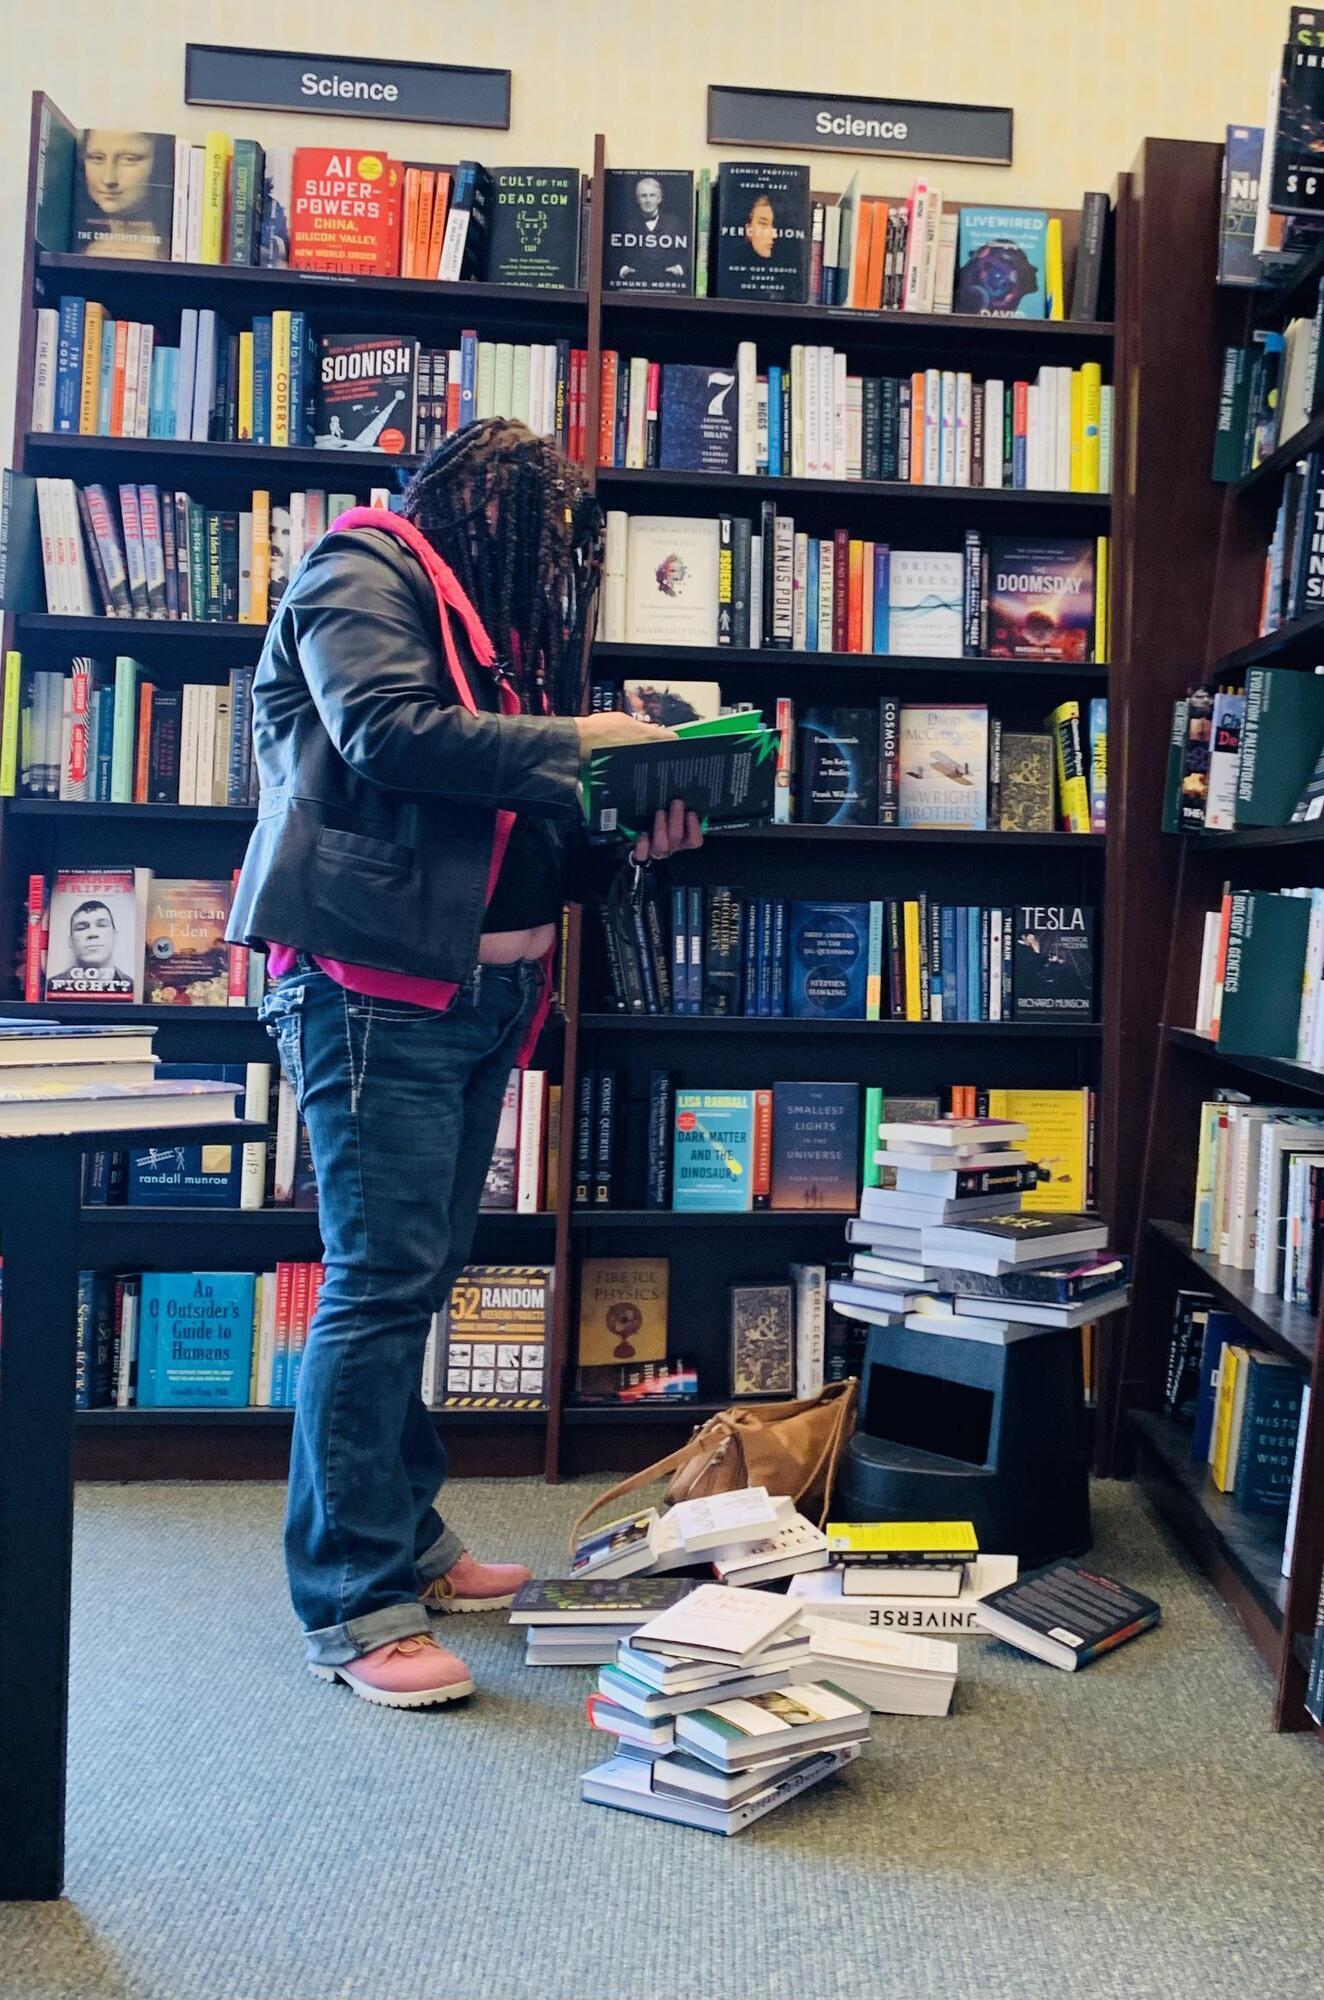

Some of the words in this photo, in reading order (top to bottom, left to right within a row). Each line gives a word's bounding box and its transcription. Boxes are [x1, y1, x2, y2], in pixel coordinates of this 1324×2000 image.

[301, 73, 399, 101] Science
[815, 112, 908, 140] Science
[325, 155, 351, 178] AI
[305, 180, 382, 200] SUPER-
[500, 176, 533, 187] CULT
[296, 199, 380, 218] POWERS
[499, 194, 535, 205] DEAD
[541, 194, 568, 205] COW
[314, 218, 359, 232] CHINA,
[965, 216, 1043, 230] LIVEWIRED
[295, 232, 336, 242] SILICON
[340, 233, 378, 246] VALLEY,
[610, 233, 688, 248] EDISON
[295, 249, 314, 258] NEW
[316, 250, 346, 259] WORLD
[348, 251, 377, 260] ORDER
[291, 317, 302, 343] how
[59, 340, 69, 373] CODE
[69, 347, 80, 368] THE
[290, 346, 299, 358] to
[321, 348, 410, 383] SOONISH
[276, 373, 287, 431] CODERS
[707, 372, 735, 416] 7
[757, 402, 766, 430] HIGGS
[703, 431, 729, 439] BRAIN
[210, 516, 218, 535] This
[210, 536, 218, 554] Idea
[776, 535, 791, 582] JANUS
[821, 546, 832, 576] WHAT
[210, 566, 218, 599] Brilliant
[821, 582, 831, 592] IS
[997, 574, 1083, 594] DOOMSDAY
[775, 585, 790, 632] POINT
[1247, 671, 1264, 717] EVOLUTION
[235, 704, 243, 736] LIGHT
[885, 703, 895, 757] COSMOS
[1238, 732, 1258, 801] PALEONTOLOGY
[154, 904, 225, 921] American
[1021, 906, 1085, 931] TESLA
[1232, 895, 1248, 935] BIOLOGY
[171, 923, 208, 938] Eden
[711, 910, 719, 951] GIANTS
[720, 891, 731, 957] SHOULDERS
[1004, 917, 1012, 932] THE
[70, 967, 115, 980] GOT
[1223, 943, 1239, 993] GENETICS
[51, 980, 131, 992] FIGHT?
[808, 988, 846, 996] HAWKING
[1017, 998, 1054, 1009] RICHARD
[1055, 998, 1089, 1009] MUNSON
[581, 1076, 592, 1115] COSMIC
[601, 1077, 612, 1115] COSMIC
[679, 1096, 701, 1107] LISA
[704, 1096, 748, 1107] RANDALL
[787, 1106, 845, 1115] SMALLEST
[795, 1122, 836, 1131] LIGHTS
[579, 1118, 589, 1162] QUERIES
[599, 1118, 609, 1161] QUERIES
[678, 1132, 704, 1143] DARK
[709, 1132, 747, 1144] MATTER
[691, 1150, 711, 1161] AND
[716, 1150, 734, 1161] THE
[787, 1150, 843, 1160] UNIVERSE
[139, 1173, 181, 1185] randall
[184, 1175, 228, 1185] munroe
[193, 1280, 213, 1297] An
[481, 1287, 545, 1309] RANDOM
[594, 1287, 659, 1301] PHYSICS
[167, 1298, 240, 1319] Outsider's
[450, 1287, 482, 1320] 52
[172, 1324, 212, 1340] Guide
[218, 1327, 232, 1340] to
[172, 1341, 230, 1360] Humans
[1257, 1454, 1289, 1466] WHO
